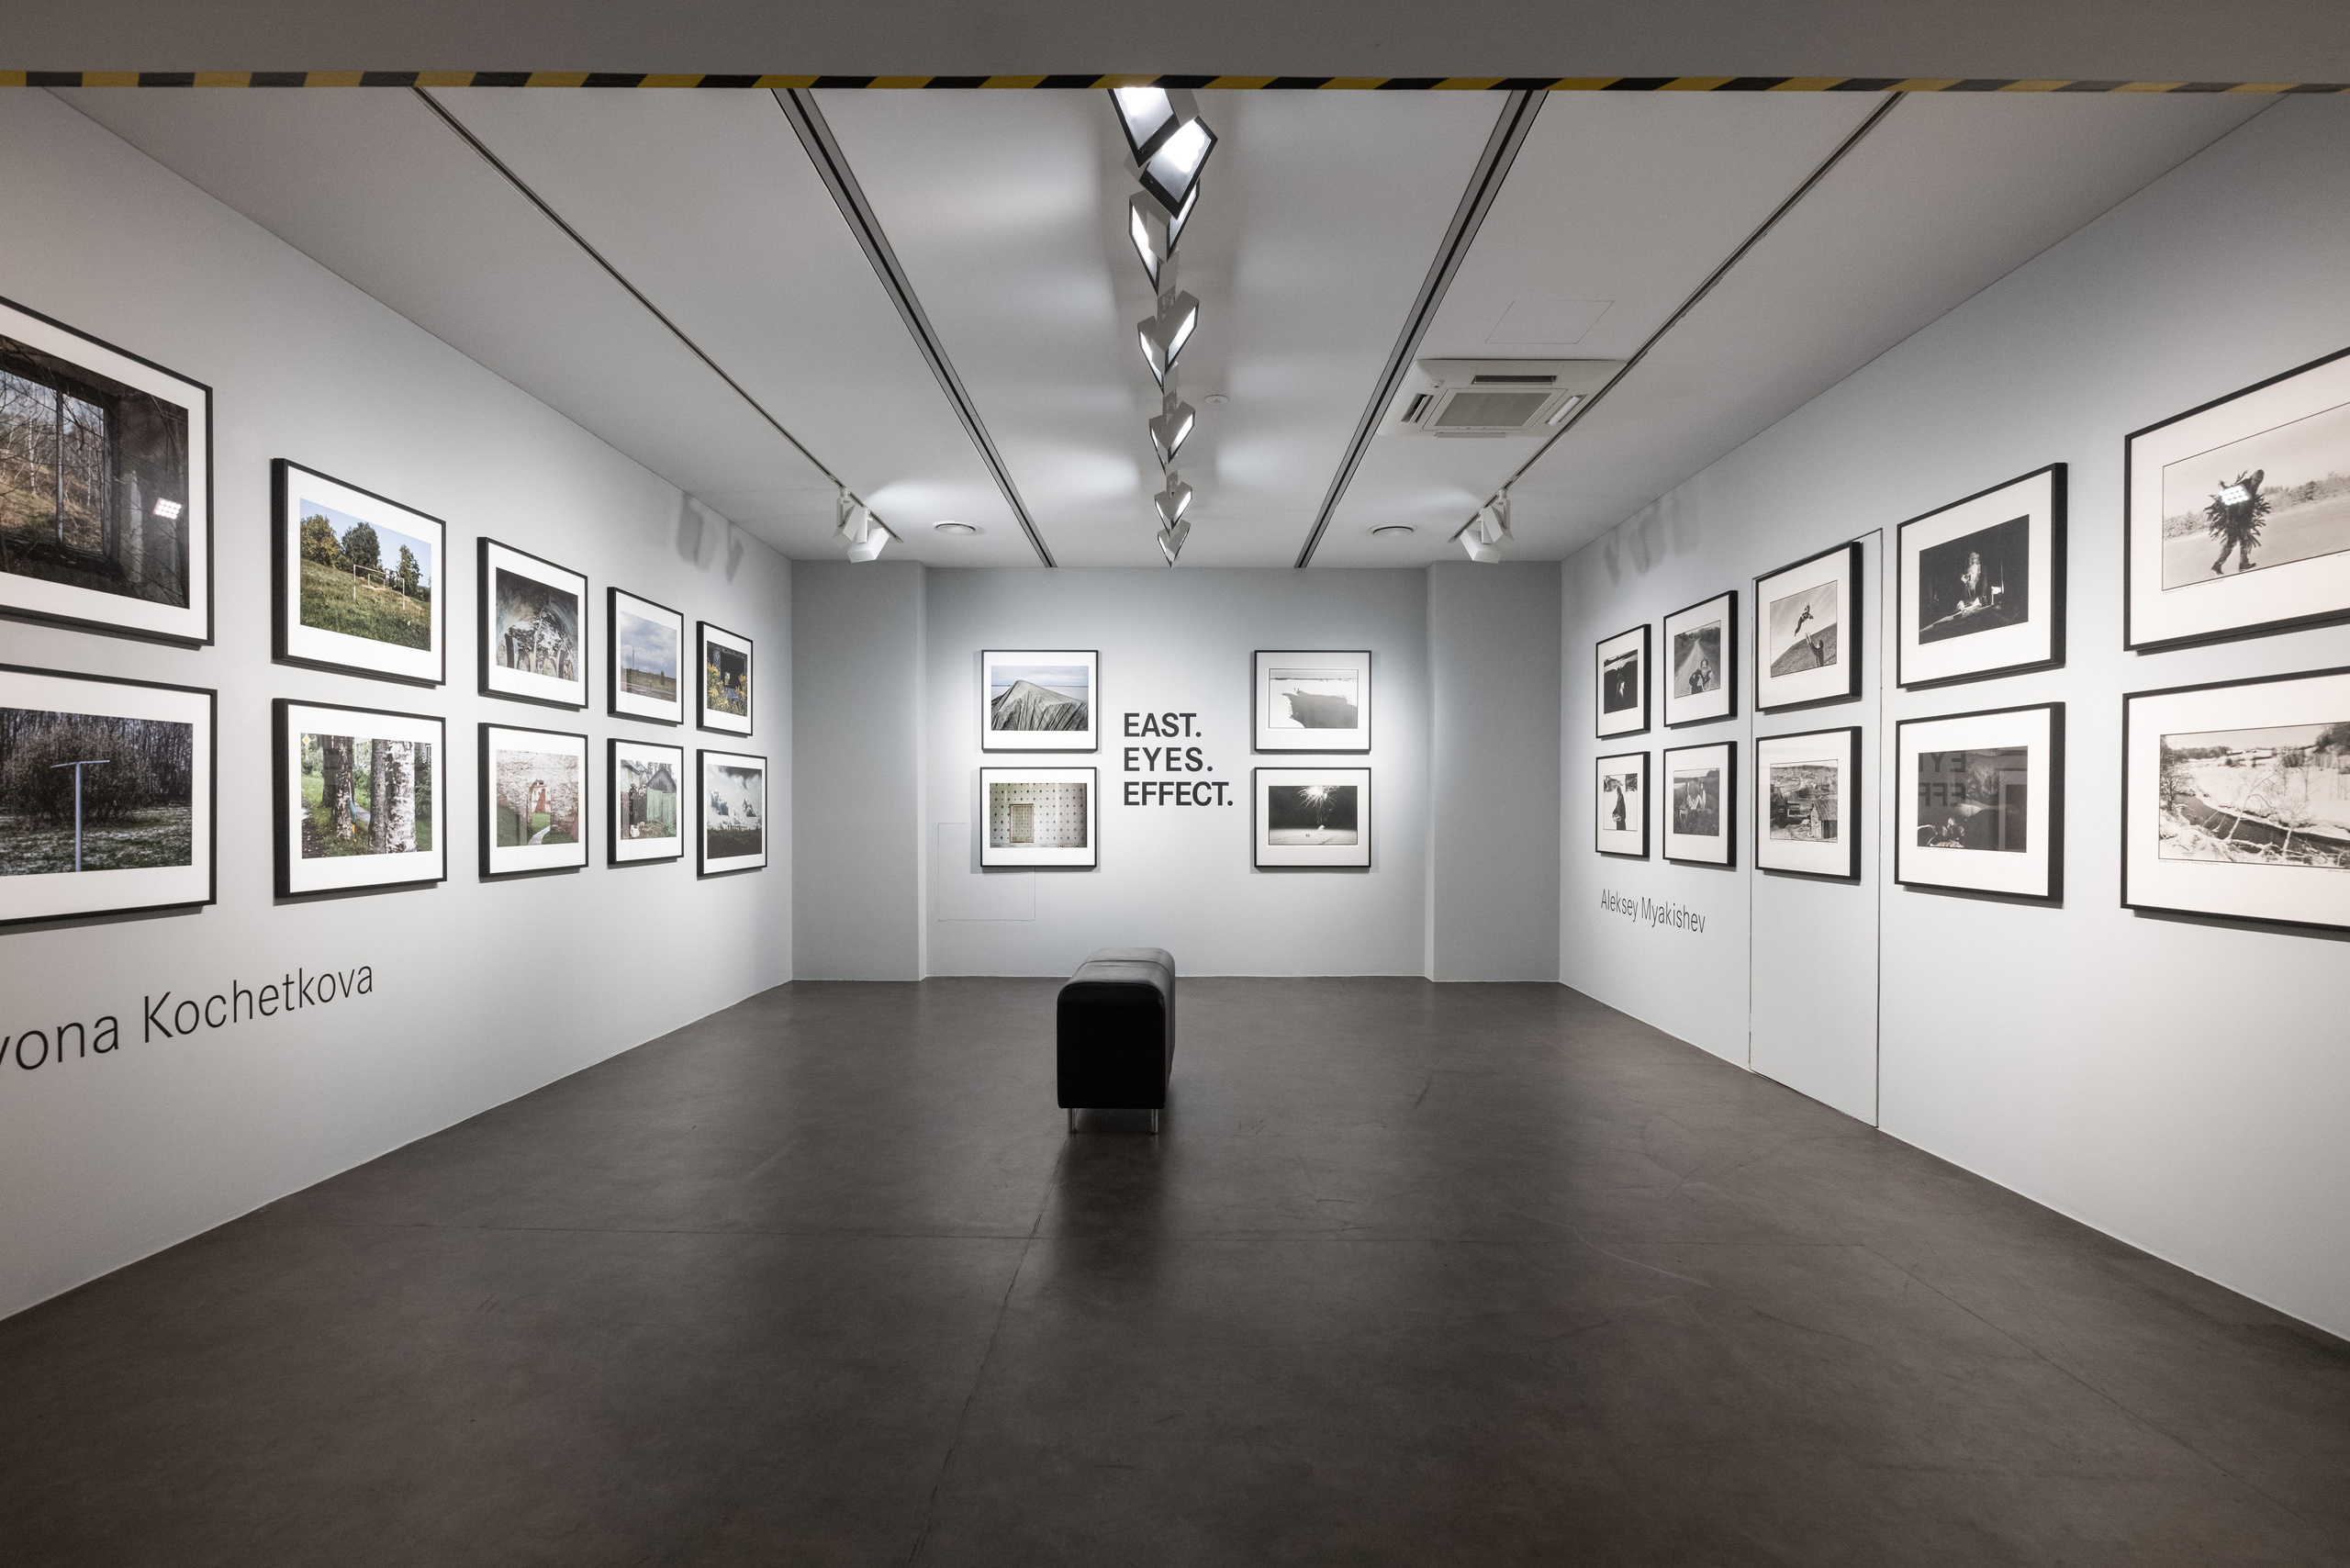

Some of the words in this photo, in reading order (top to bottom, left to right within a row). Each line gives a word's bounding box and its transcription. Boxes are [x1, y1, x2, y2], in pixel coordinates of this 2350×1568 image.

[1124, 712, 1202, 737] EAST.
[1124, 746, 1213, 772] EYES.
[1124, 781, 1234, 806] EFFECT.
[1600, 889, 1639, 923] Aleksey
[1641, 896, 1706, 934] Myakishev
[143, 966, 374, 1043] Kochetkova
